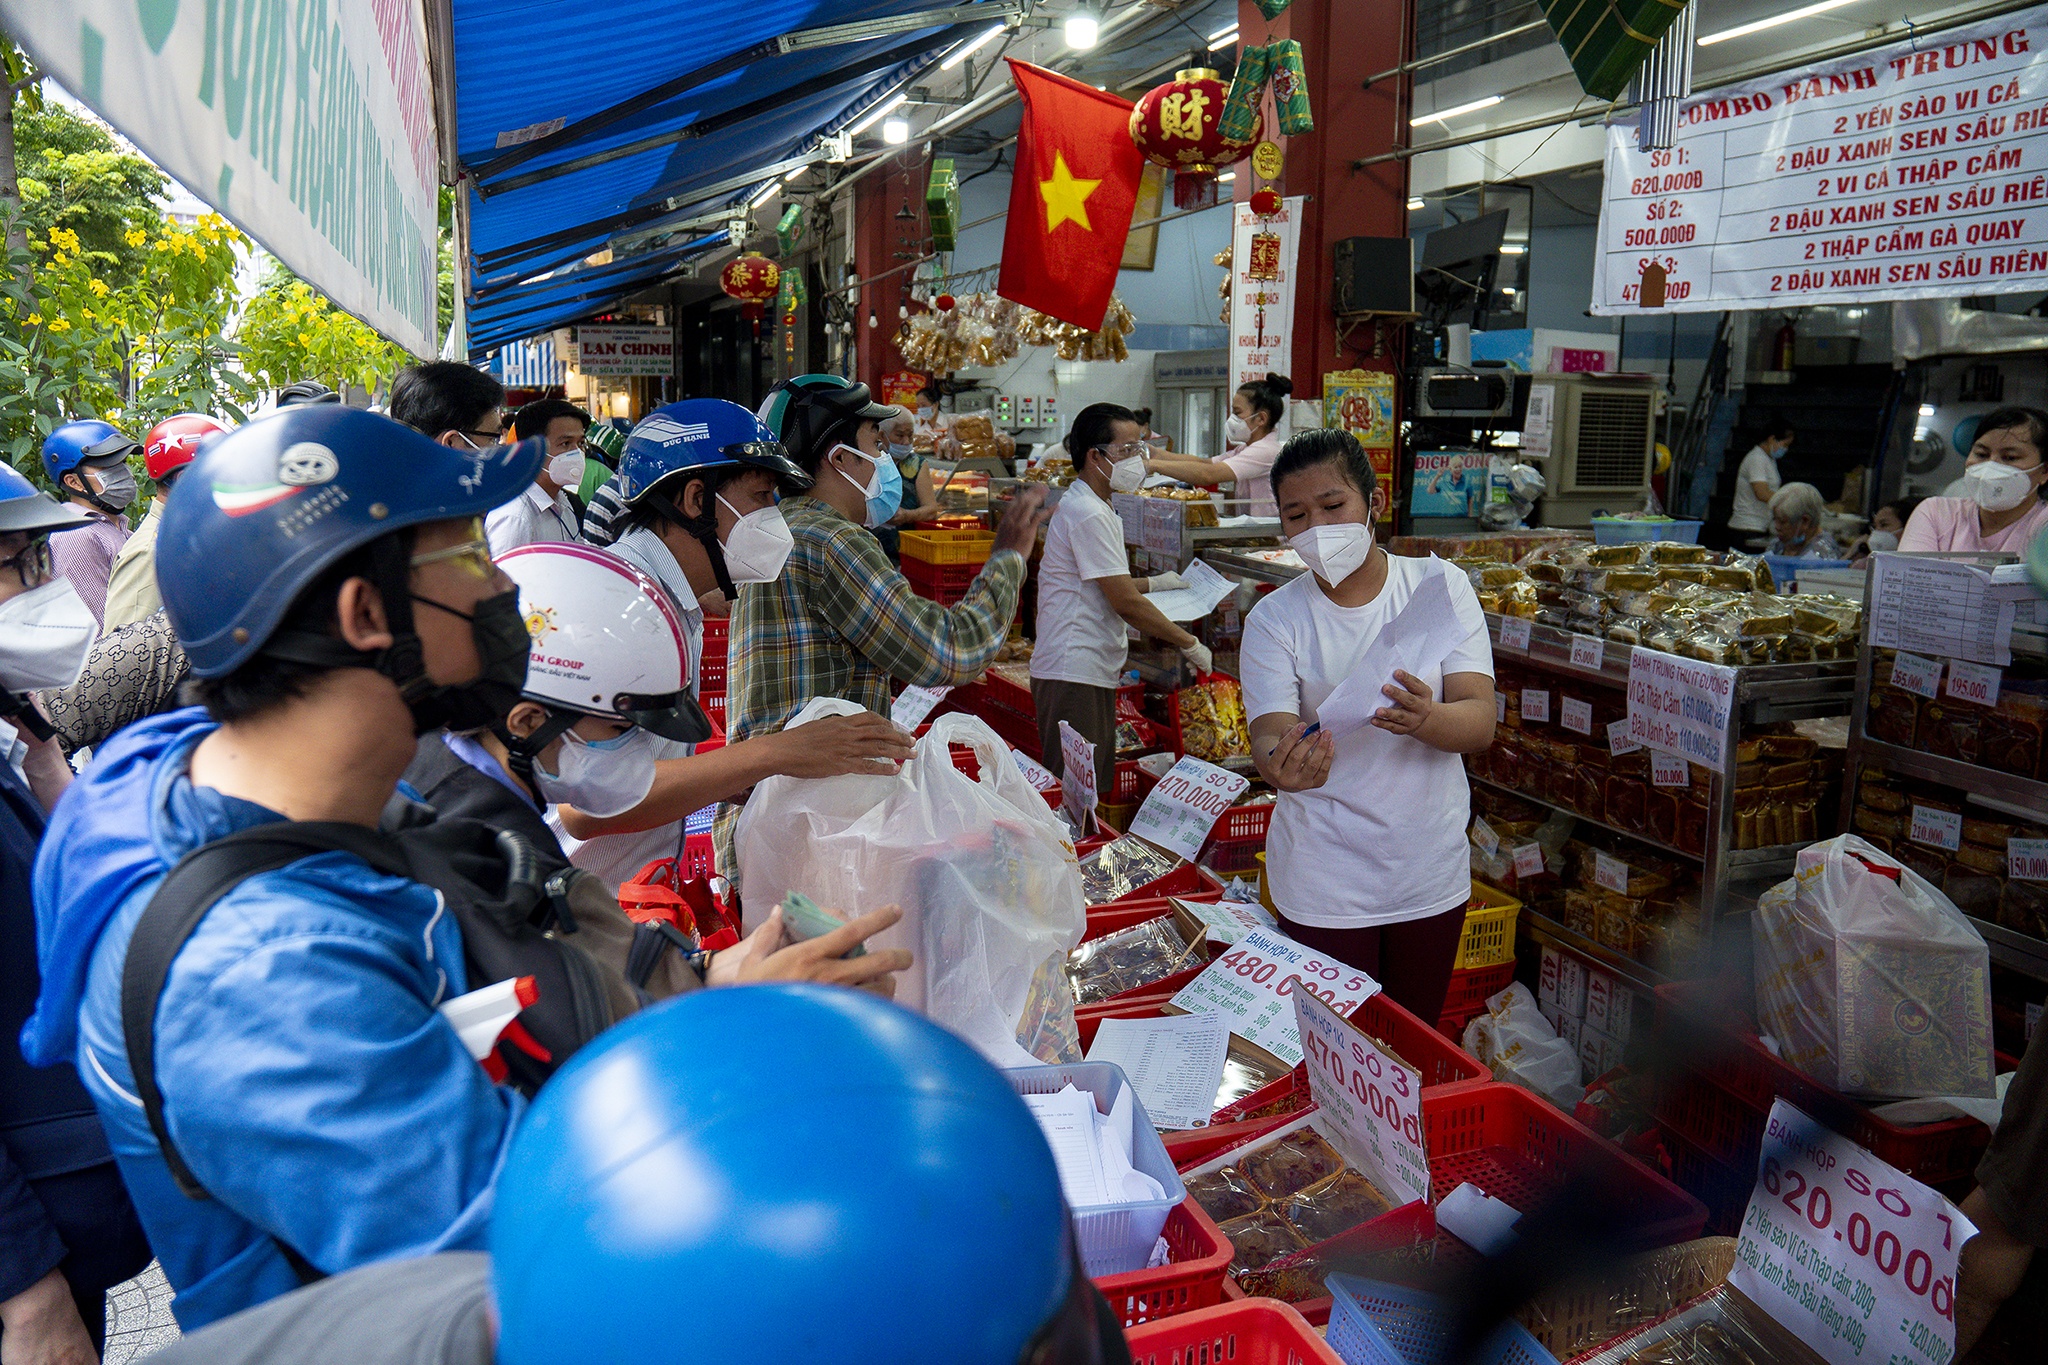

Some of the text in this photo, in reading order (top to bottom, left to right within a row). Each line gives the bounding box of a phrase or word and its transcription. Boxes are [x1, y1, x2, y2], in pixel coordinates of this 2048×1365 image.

[1889, 29, 2030, 81] TRUNG
[1160, 88, 1211, 142] 財
[1834, 76, 2020, 134] 2 YẾN SÀO VI CÁ
[1776, 112, 2007, 173] 2 ĐẬU XANH SEN SẦU
[1631, 170, 1703, 195] 620.000Đ
[1818, 144, 2023, 197] 2 VI CÁ THẬP CẨM
[1646, 198, 1684, 221] Số 2:
[1770, 182, 1995, 234] 2 ĐẬU XANH SEN SẦU
[1625, 223, 1697, 247] 500.000Đ
[1805, 218, 2027, 260] 2 THẬP CẨM GÀ QUAY
[1771, 276, 1782, 293] 2
[1789, 265, 1825, 294] ĐẬU
[1830, 265, 1880, 289] XANH
[1887, 261, 1931, 284] SEN
[1937, 252, 1982, 280] SẦU
[583, 342, 673, 356] LAN CHINH
[547, 656, 585, 670] GROUP
[1632, 651, 1651, 672] BÁNH
[1652, 659, 1675, 680] TRUNG
[1676, 666, 1691, 684] THU
[1891, 669, 1923, 692] 265.000
[1952, 677, 1988, 700] 195.000
[1647, 717, 1664, 743] Xanh
[1664, 723, 1679, 749] Sen
[1034, 775, 1050, 791] 2
[1158, 775, 1233, 817] 470.000đ
[1205, 773, 1228, 787] SỐ
[1227, 777, 1245, 792] 3
[1655, 769, 1684, 784] 210.000
[1912, 823, 1944, 845] 210.000
[2010, 857, 2048, 879] 150.000
[1245, 932, 1273, 954] BÁNH
[1268, 941, 1287, 960] HỘP
[1303, 959, 1341, 981] SỐ
[1343, 976, 1367, 992] 5
[1541, 954, 1557, 992] 412
[1193, 983, 1207, 996] Sen
[1220, 997, 1237, 1013] Xanh
[1233, 1001, 1249, 1018] Sen
[1253, 1013, 1271, 1030] 300g
[1201, 968, 1209, 978] 2
[1206, 970, 1222, 988] Thập
[1239, 990, 1258, 1003] quay
[1264, 1001, 1283, 1016] 300g
[1589, 979, 1607, 1018] 412
[1300, 998, 1319, 1032] BÁNH
[1318, 1015, 1332, 1040] HỘP
[1351, 1041, 1383, 1079] SỐ
[1391, 1065, 1411, 1098] 3
[1306, 1029, 1421, 1149] 470.000đ
[1767, 1116, 1804, 1152] BÁNH
[1805, 1142, 1837, 1173] HỘP
[1843, 1167, 1912, 1219] SỐ
[1762, 1157, 1955, 1323] 620.000đ
[1746, 1204, 1757, 1226] 2
[1755, 1205, 1772, 1240] Yến
[1770, 1223, 1788, 1251] sào
[1796, 1237, 1811, 1264] Cá
[1809, 1248, 1833, 1287] Thập
[1831, 1261, 1853, 1297] cẩm
[1851, 1280, 1878, 1319] 300g
[1737, 1236, 1867, 1354] 2 Đậu Xanh Sen Sầu Riêng 300g
